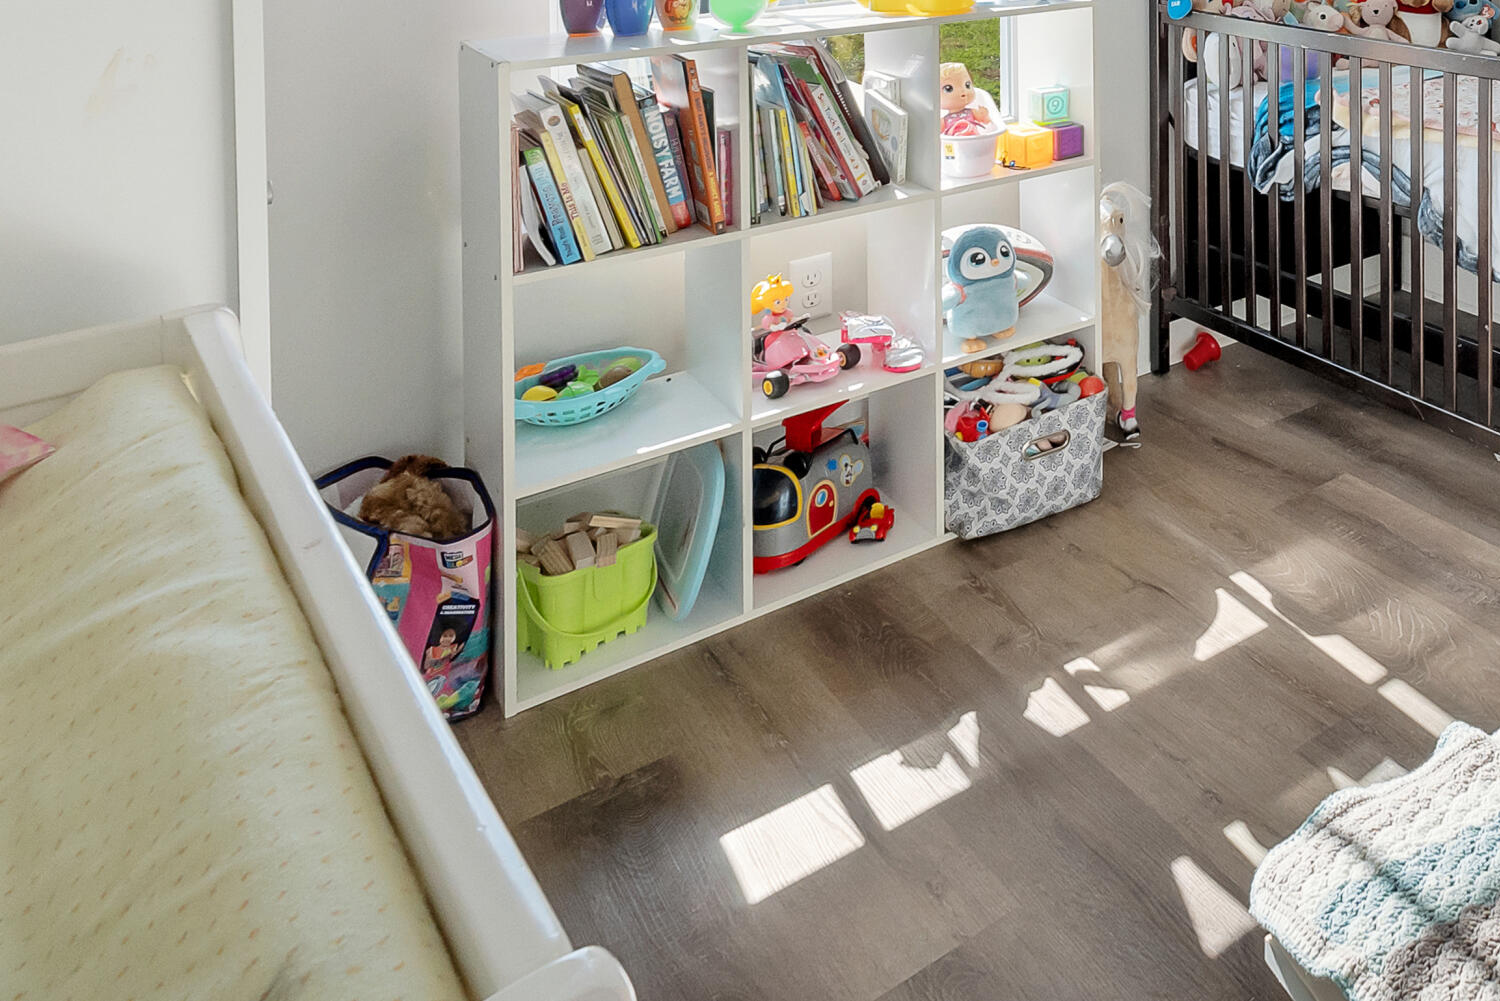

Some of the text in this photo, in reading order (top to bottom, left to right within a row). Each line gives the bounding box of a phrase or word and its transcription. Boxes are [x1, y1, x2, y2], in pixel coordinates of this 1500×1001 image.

[643, 108, 672, 159] NOISY
[658, 157, 683, 198] FARM
[567, 203, 580, 220] This
